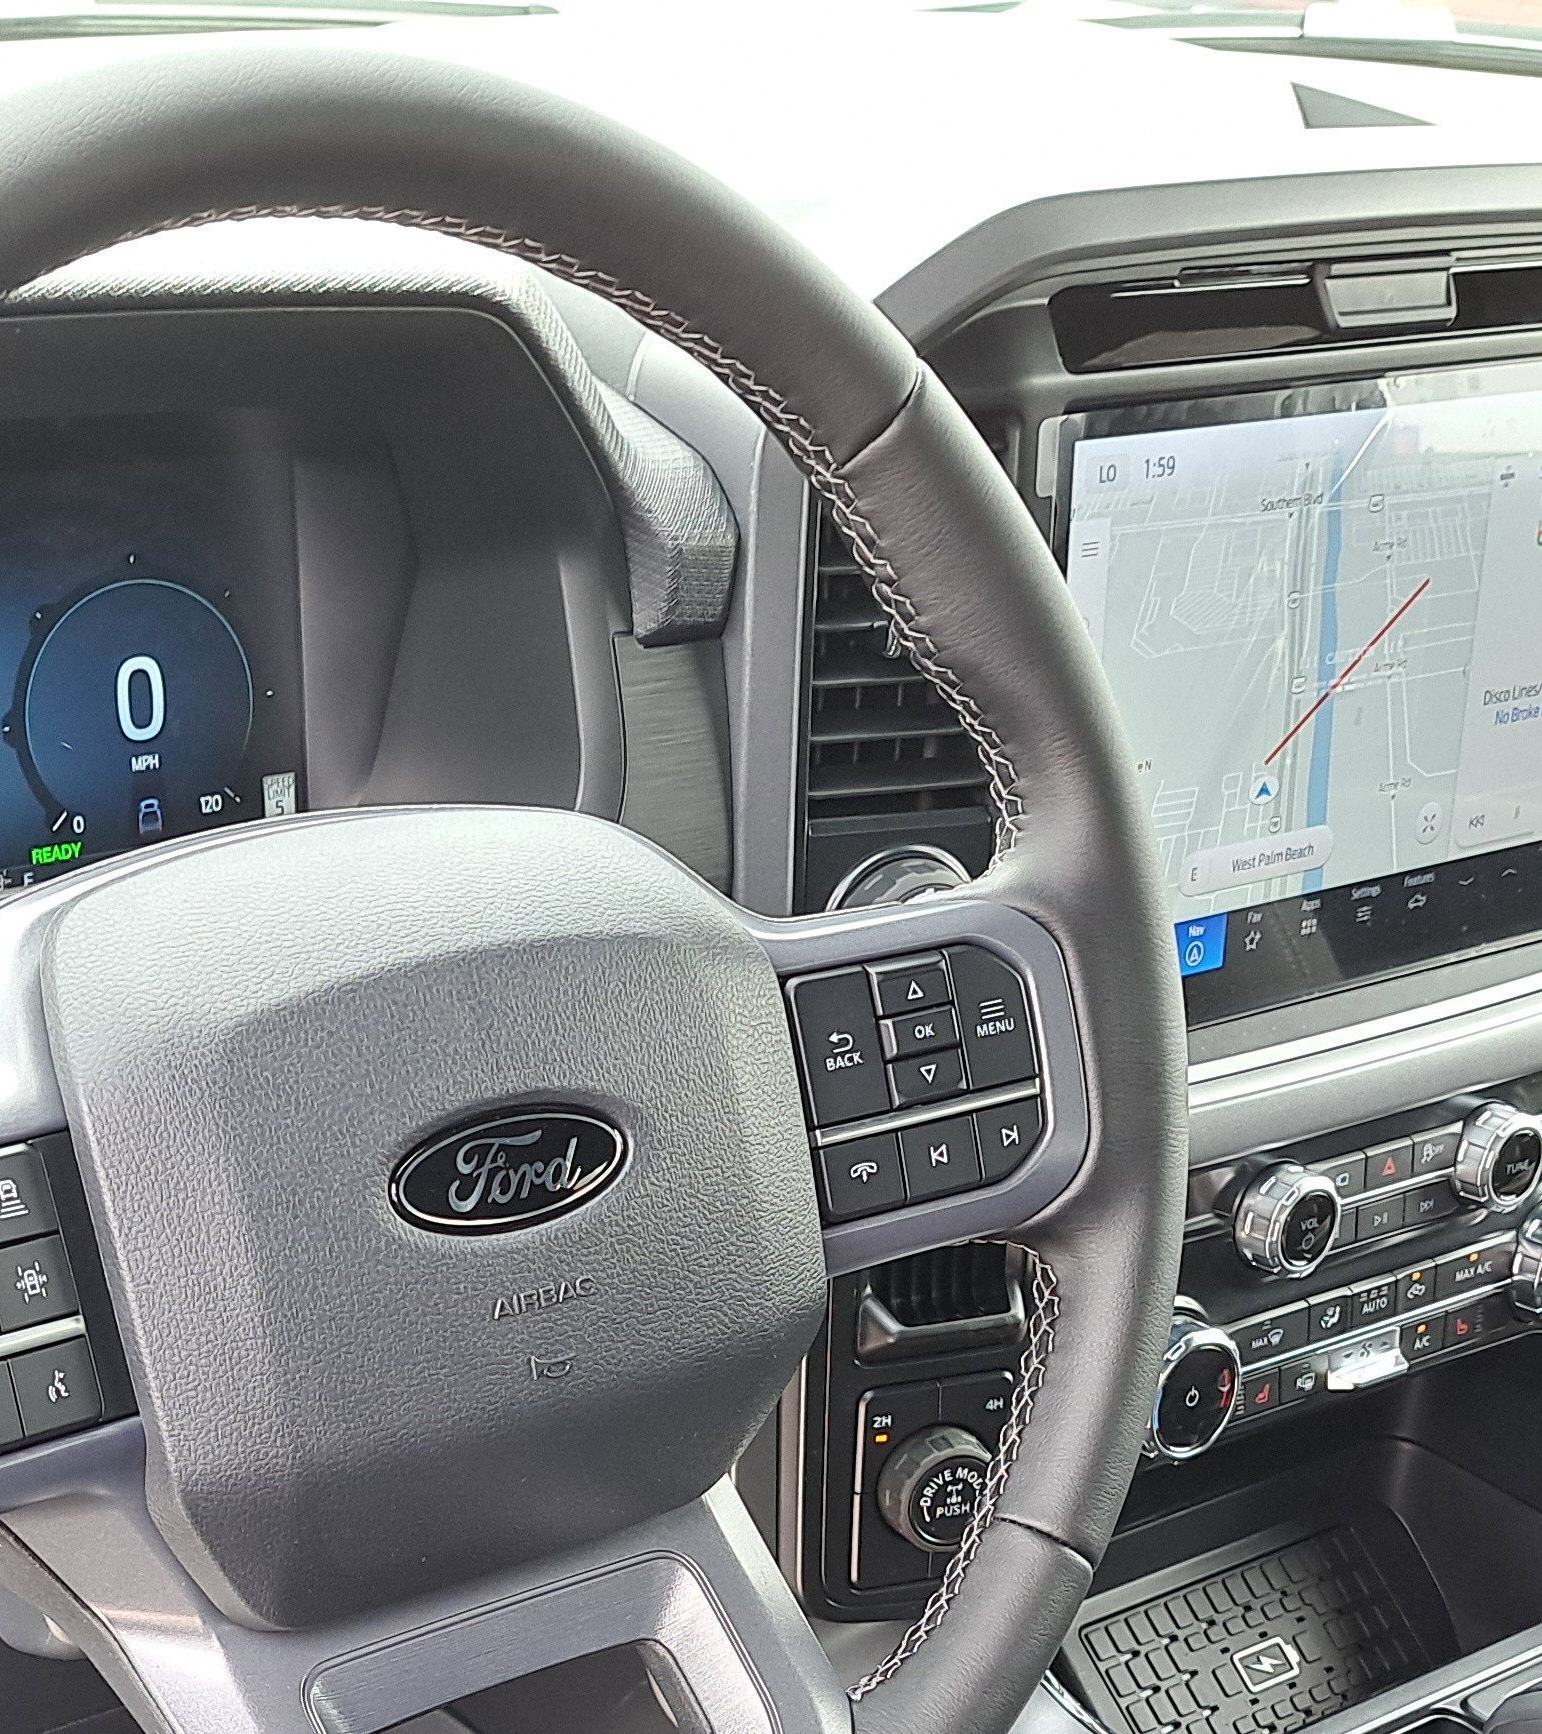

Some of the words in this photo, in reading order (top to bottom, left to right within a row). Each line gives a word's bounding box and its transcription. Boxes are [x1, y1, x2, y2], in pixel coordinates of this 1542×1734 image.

[1099, 464, 1117, 484] LO
[1144, 455, 1176, 479] 1:59
[116, 656, 164, 741] 0
[1483, 689, 1510, 706] Disco
[1494, 709, 1509, 725] No
[1511, 705, 1540, 722] Broke
[131, 752, 160, 772] MPH
[200, 793, 223, 814] 120
[275, 799, 285, 816] 5
[72, 816, 85, 834] 0
[32, 841, 81, 865] READY
[1232, 853, 1256, 873] West
[1258, 849, 1284, 868] Palm
[1285, 843, 1315, 861] Beach
[1191, 867, 1198, 882] E
[914, 1024, 936, 1039] OK
[975, 1017, 1016, 1038] MENU
[825, 1051, 864, 1072] BACK
[447, 1129, 583, 1214] Ford
[1506, 1159, 1532, 1175] TUNE
[1300, 1216, 1319, 1231] VOL
[1455, 1266, 1474, 1282] MAX
[1476, 1261, 1493, 1274] A/C
[493, 1275, 596, 1320] AIRBAG
[1361, 1297, 1388, 1315] AUTO
[1251, 1335, 1269, 1350] MAX
[1413, 1333, 1432, 1350] A/C
[985, 1398, 1004, 1411] 4H
[873, 1415, 892, 1429] 2H
[919, 1468, 954, 1507] DRIVE
[935, 1501, 971, 1519] PUSH
